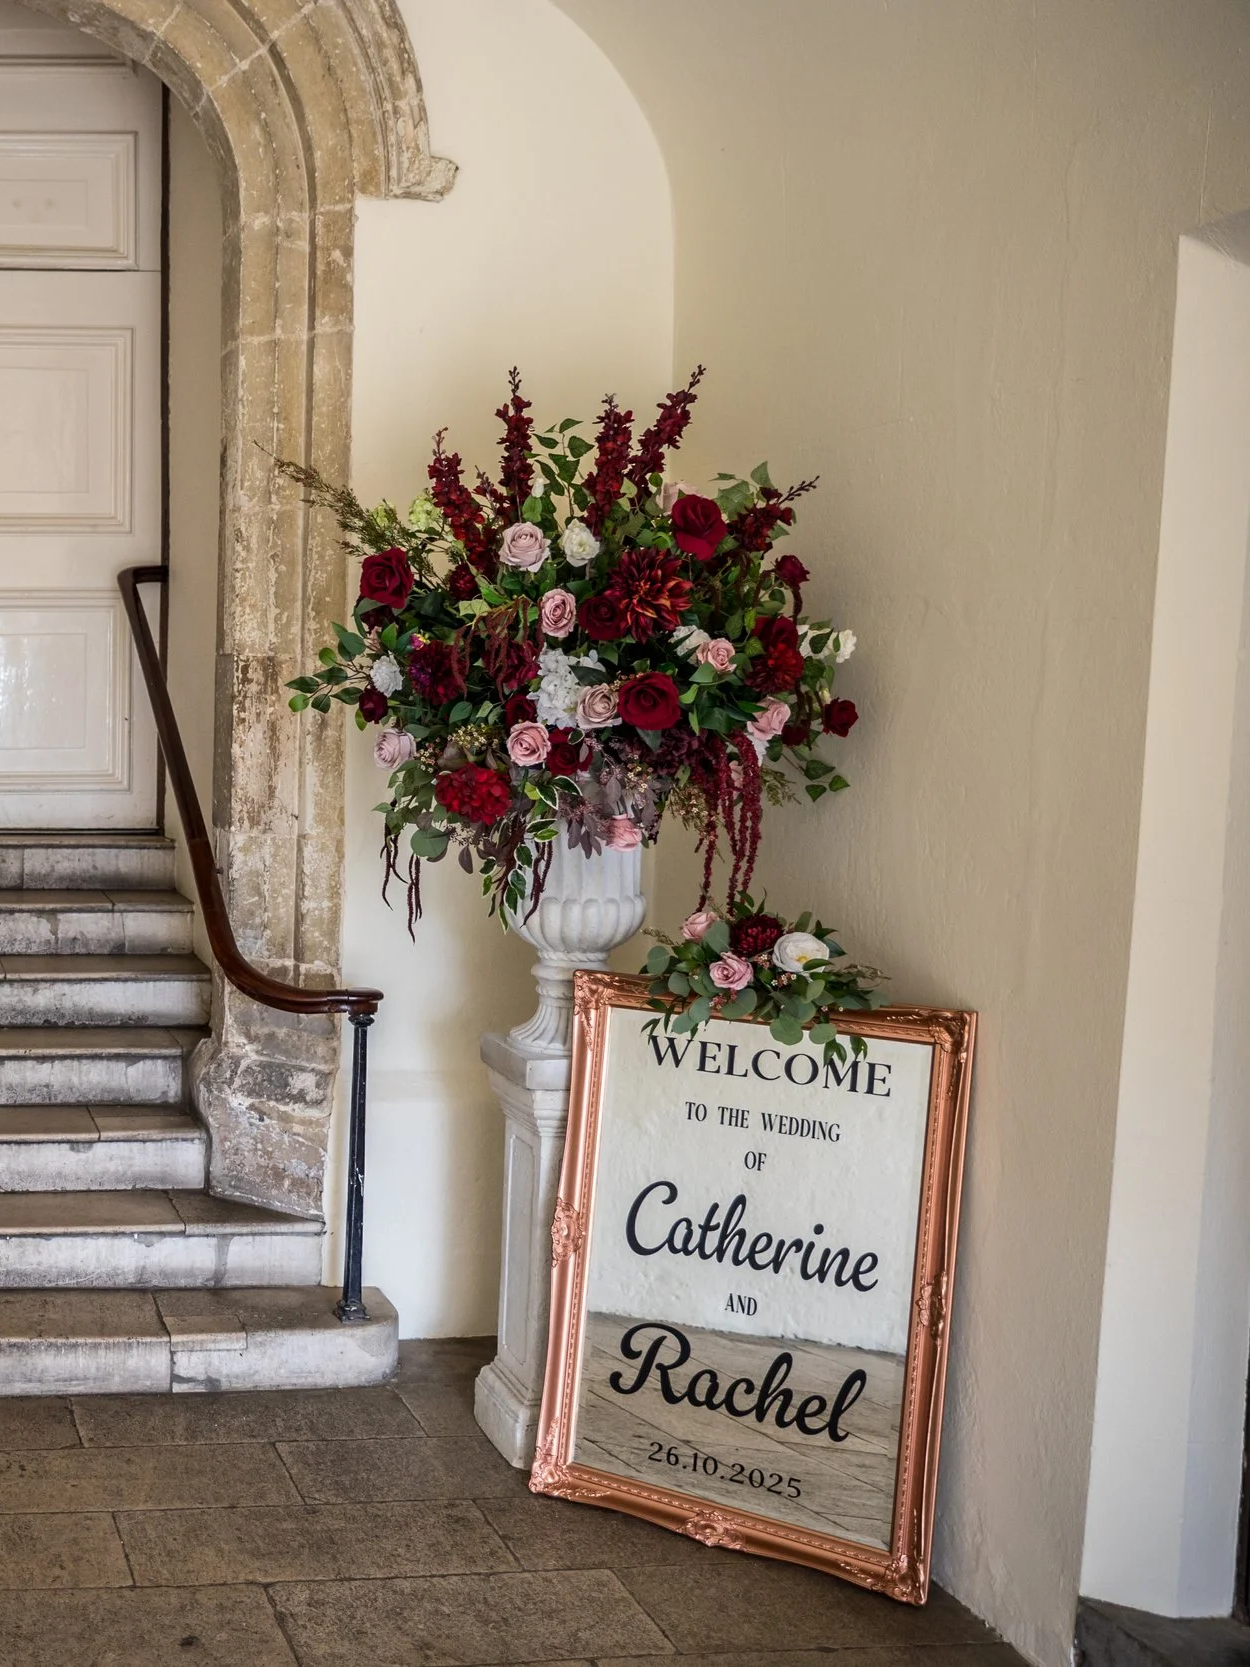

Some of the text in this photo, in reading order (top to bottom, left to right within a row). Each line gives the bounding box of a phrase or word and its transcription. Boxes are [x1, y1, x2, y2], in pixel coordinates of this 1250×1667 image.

[649, 1035, 892, 1097] WELCOME
[685, 1102, 841, 1142] TO THE WEDDING
[744, 1151, 767, 1171] OF
[625, 1180, 879, 1292] Catherine
[724, 1293, 758, 1316] AND
[609, 1323, 867, 1442] Rachel
[648, 1442, 802, 1499] 26.10.2025
